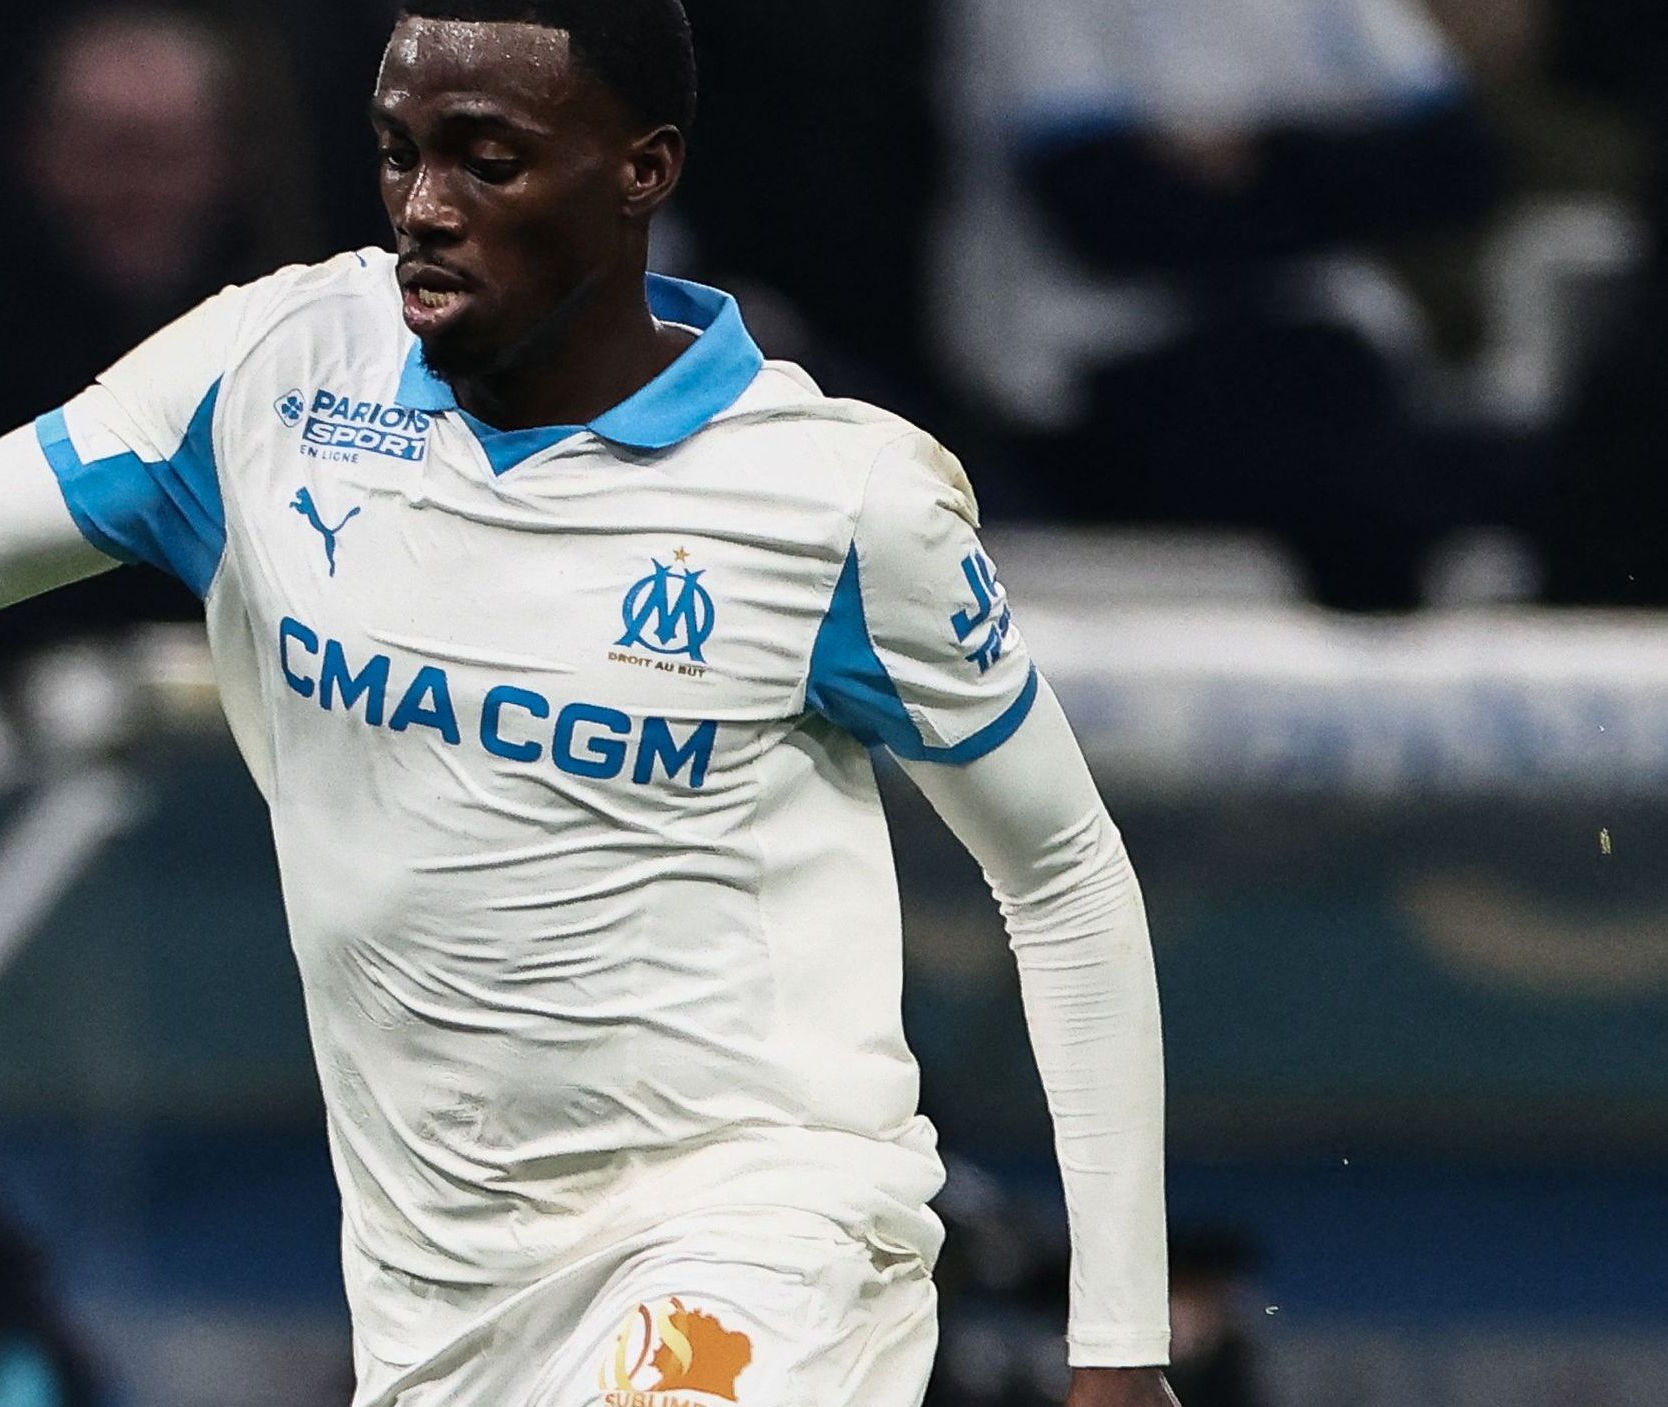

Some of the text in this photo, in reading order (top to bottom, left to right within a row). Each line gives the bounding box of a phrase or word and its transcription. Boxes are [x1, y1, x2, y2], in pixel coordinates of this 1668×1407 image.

[299, 444, 360, 464] EN LIGNE
[306, 422, 425, 461] SPORT
[608, 651, 706, 678] DROIT AU BUT
[279, 616, 719, 789] CMA CGM
